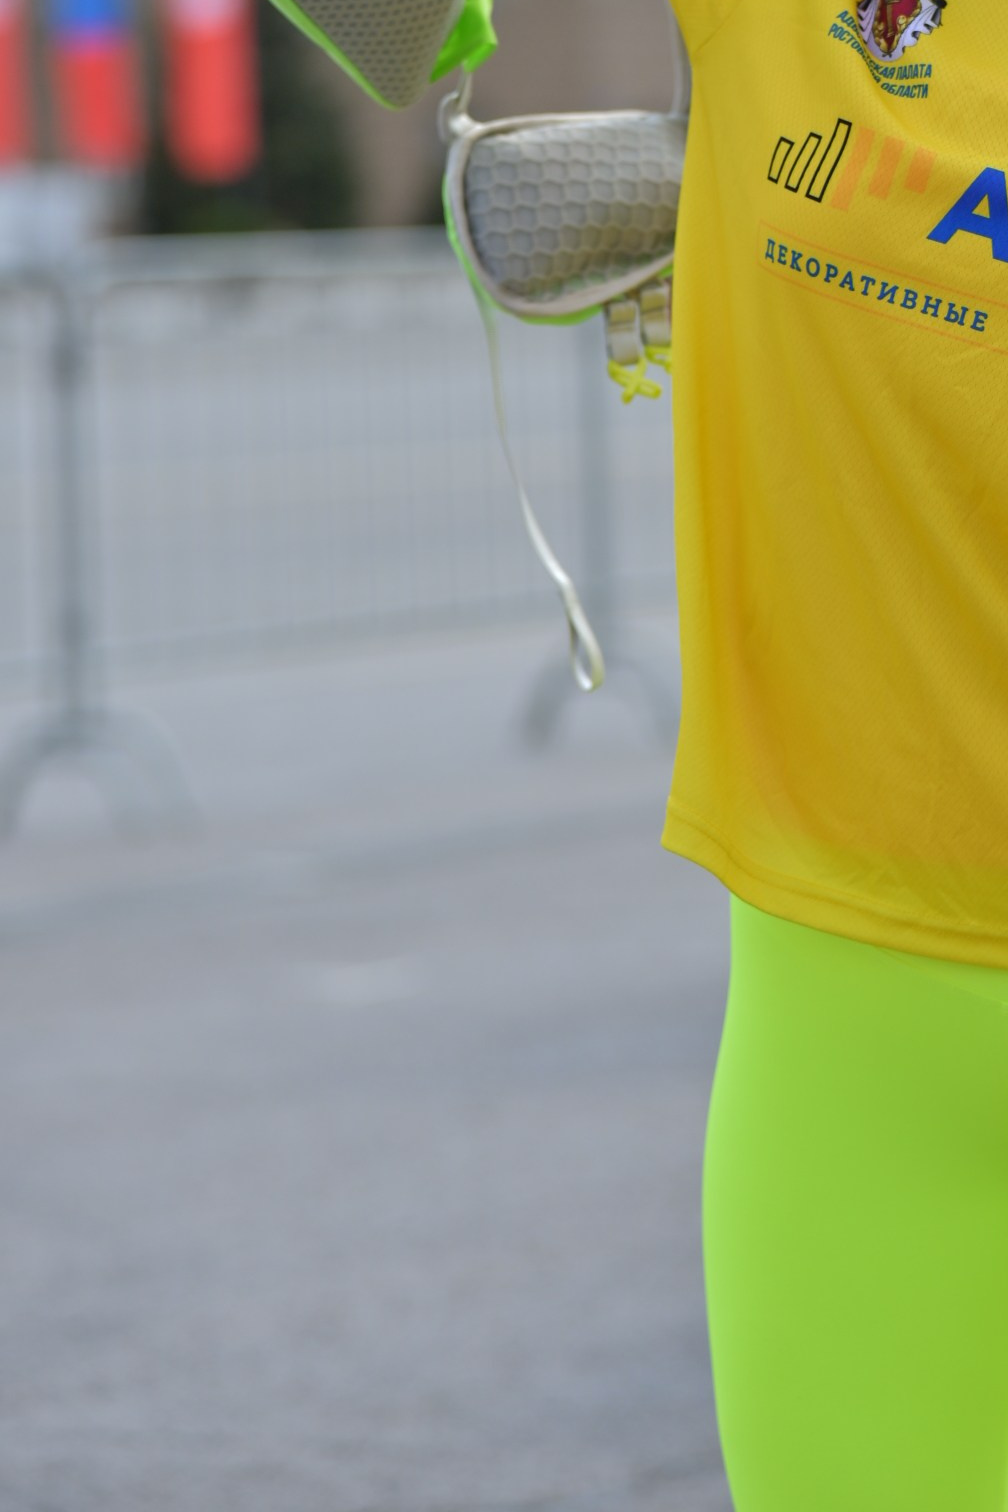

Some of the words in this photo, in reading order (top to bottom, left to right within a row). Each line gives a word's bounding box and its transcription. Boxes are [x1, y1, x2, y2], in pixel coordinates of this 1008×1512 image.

[895, 63, 933, 81] ПАЛАТА
[881, 82, 929, 99] ОБЛАСТИ
[765, 238, 989, 332] ДЕКОРАТИВНЫЕ
